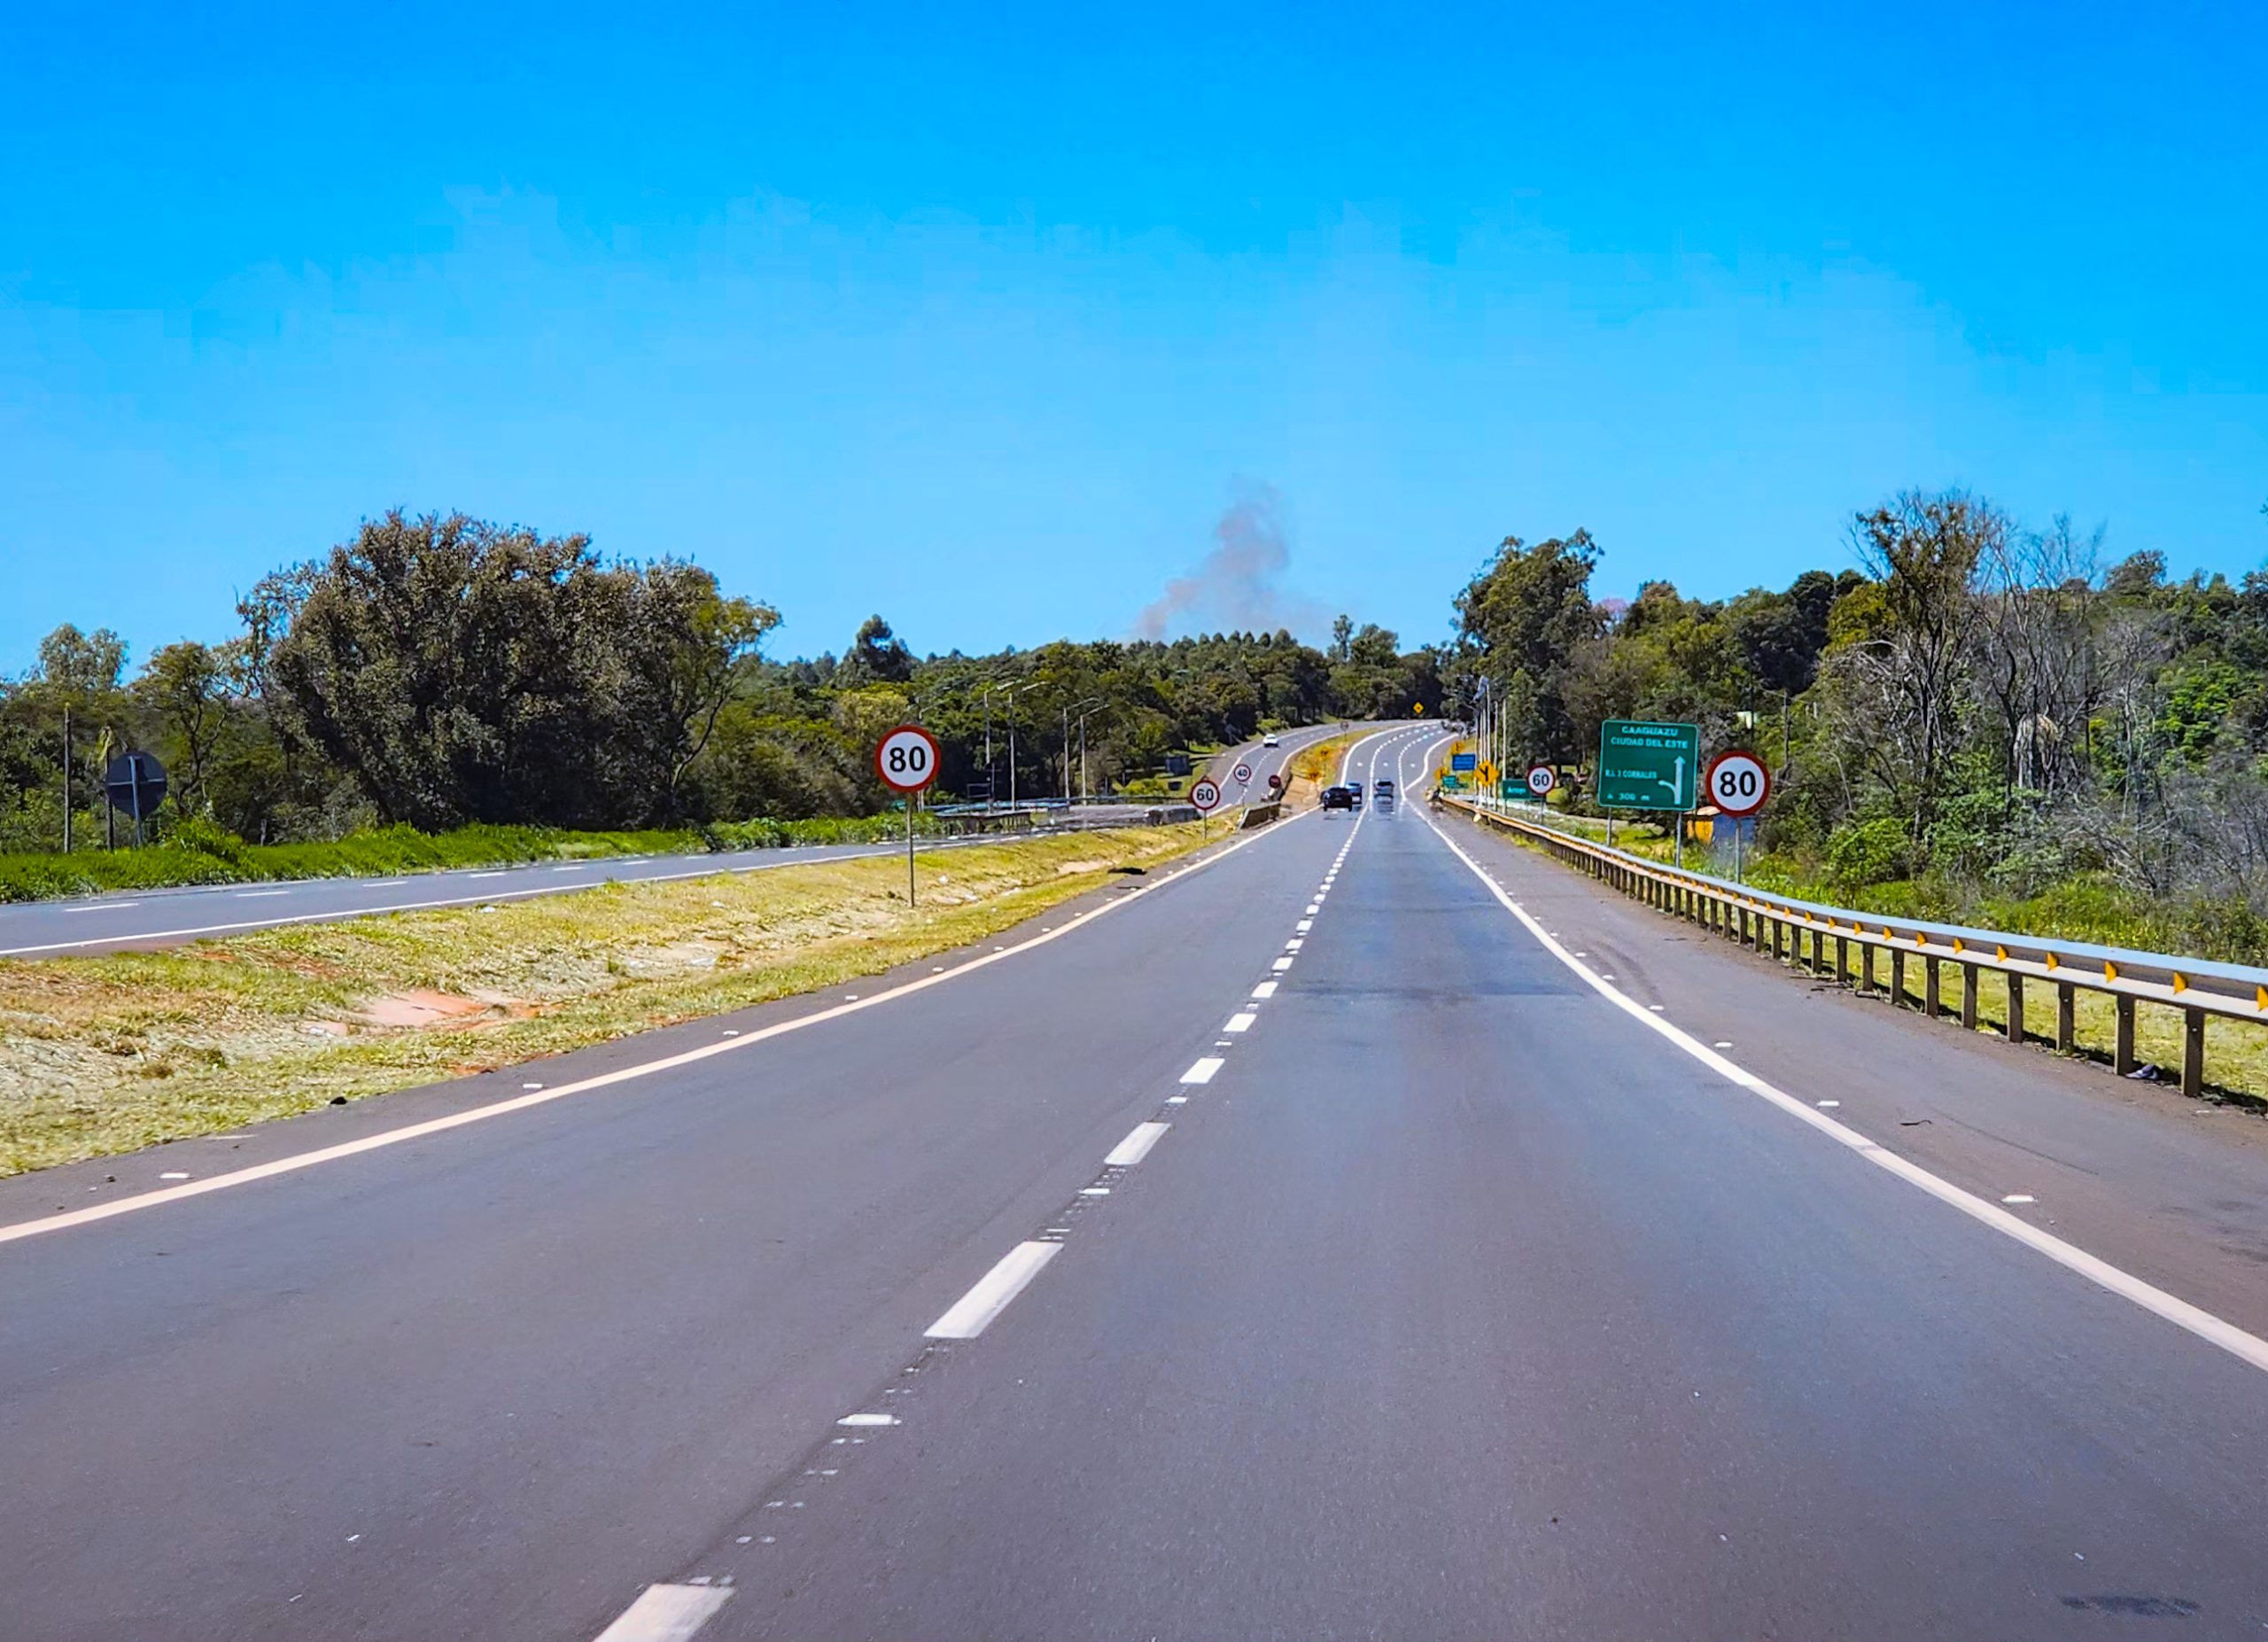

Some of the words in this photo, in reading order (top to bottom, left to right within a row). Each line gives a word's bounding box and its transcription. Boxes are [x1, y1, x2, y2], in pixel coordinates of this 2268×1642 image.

[1611, 736, 1643, 746] CIUDAD
[1645, 737, 1663, 747] DEL
[1665, 739, 1688, 749] ESTE
[889, 745, 926, 773] 80
[1237, 768, 1247, 777] 40
[1533, 774, 1550, 786] 60
[1720, 770, 1757, 797] 80
[1196, 788, 1214, 801] 60
